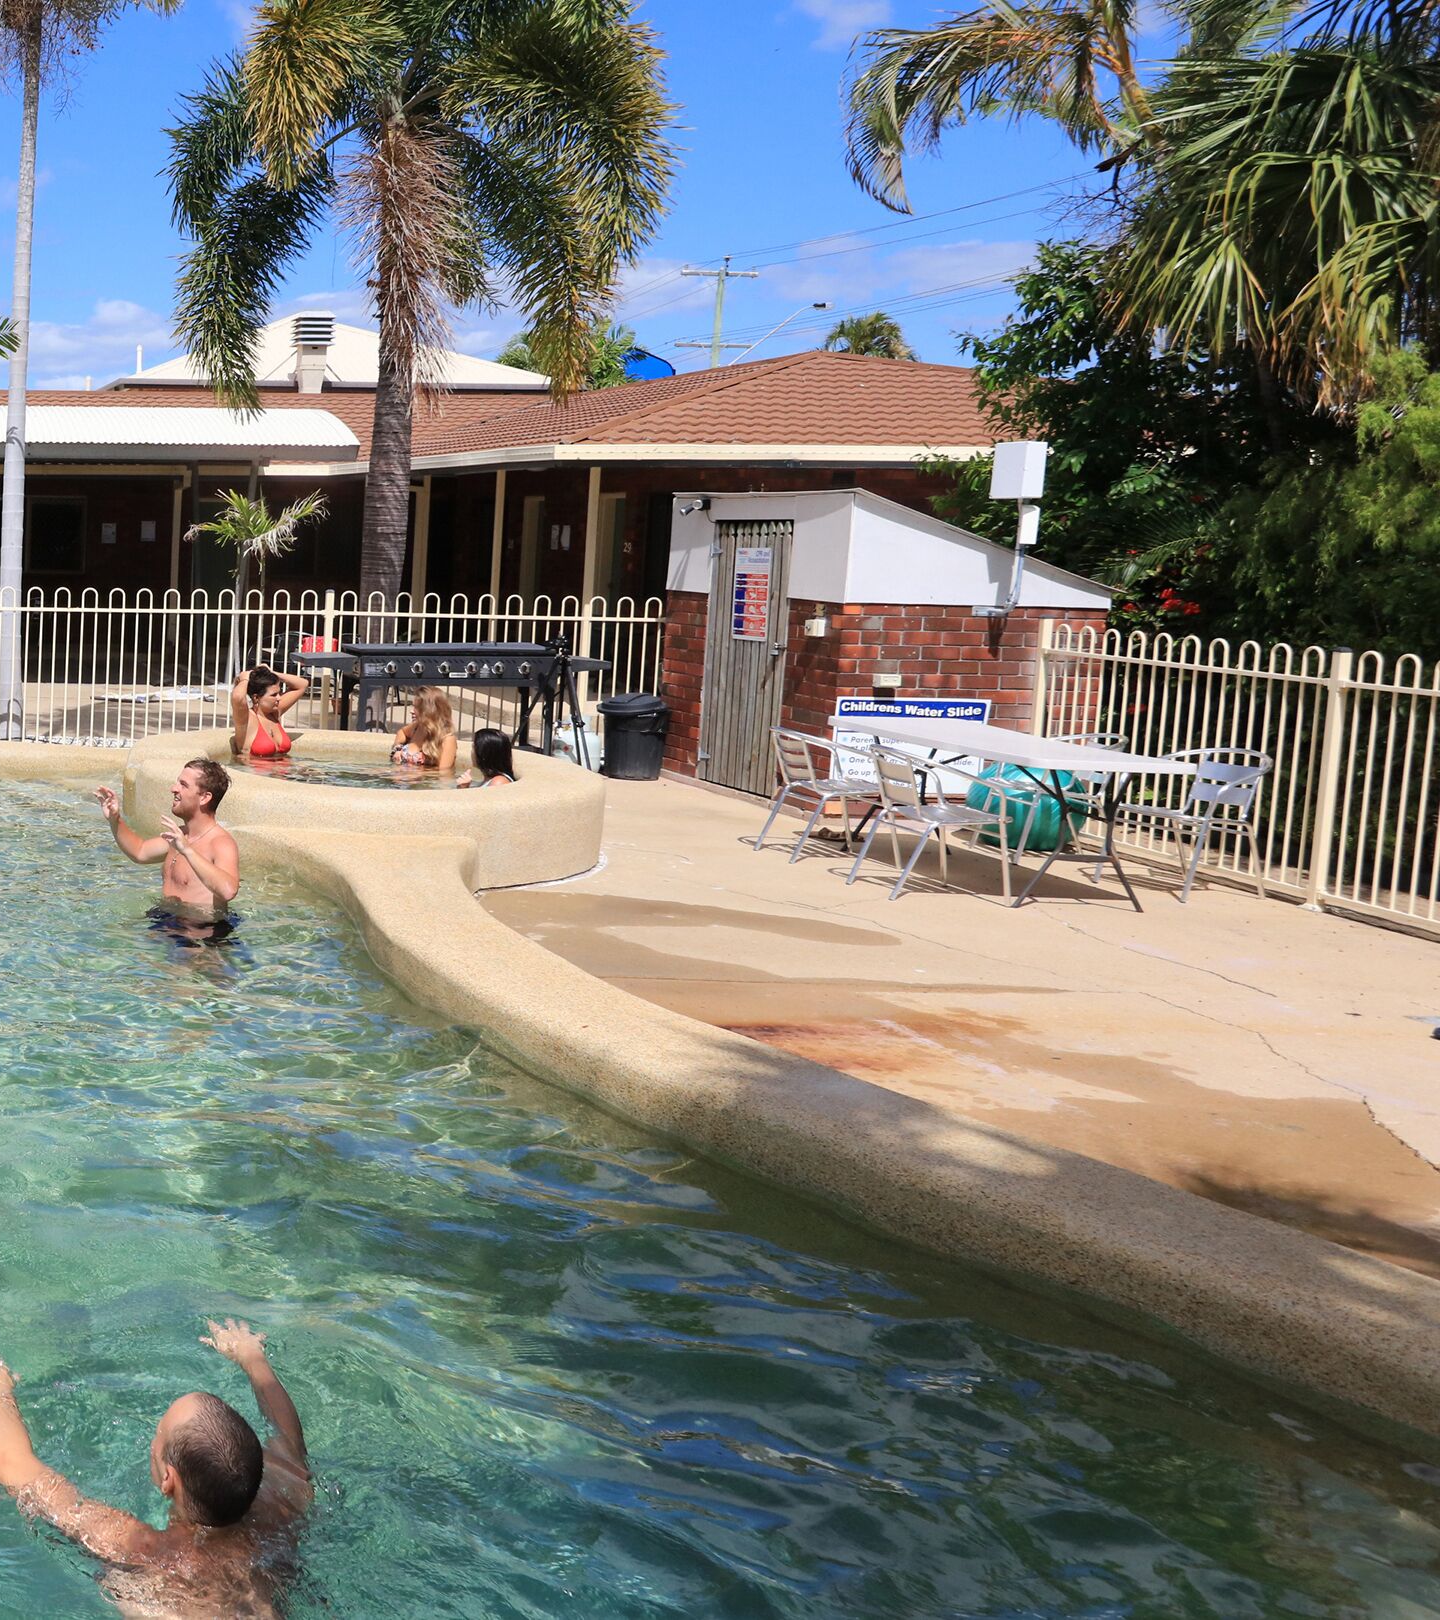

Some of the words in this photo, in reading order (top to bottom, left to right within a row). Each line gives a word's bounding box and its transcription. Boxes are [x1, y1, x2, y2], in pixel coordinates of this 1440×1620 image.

[622, 542, 632, 553] 29
[841, 701, 903, 714] Childrens
[905, 704, 944, 717] Water
[947, 706, 982, 717] Slide
[849, 756, 866, 764] One
[848, 768, 859, 776] Go
